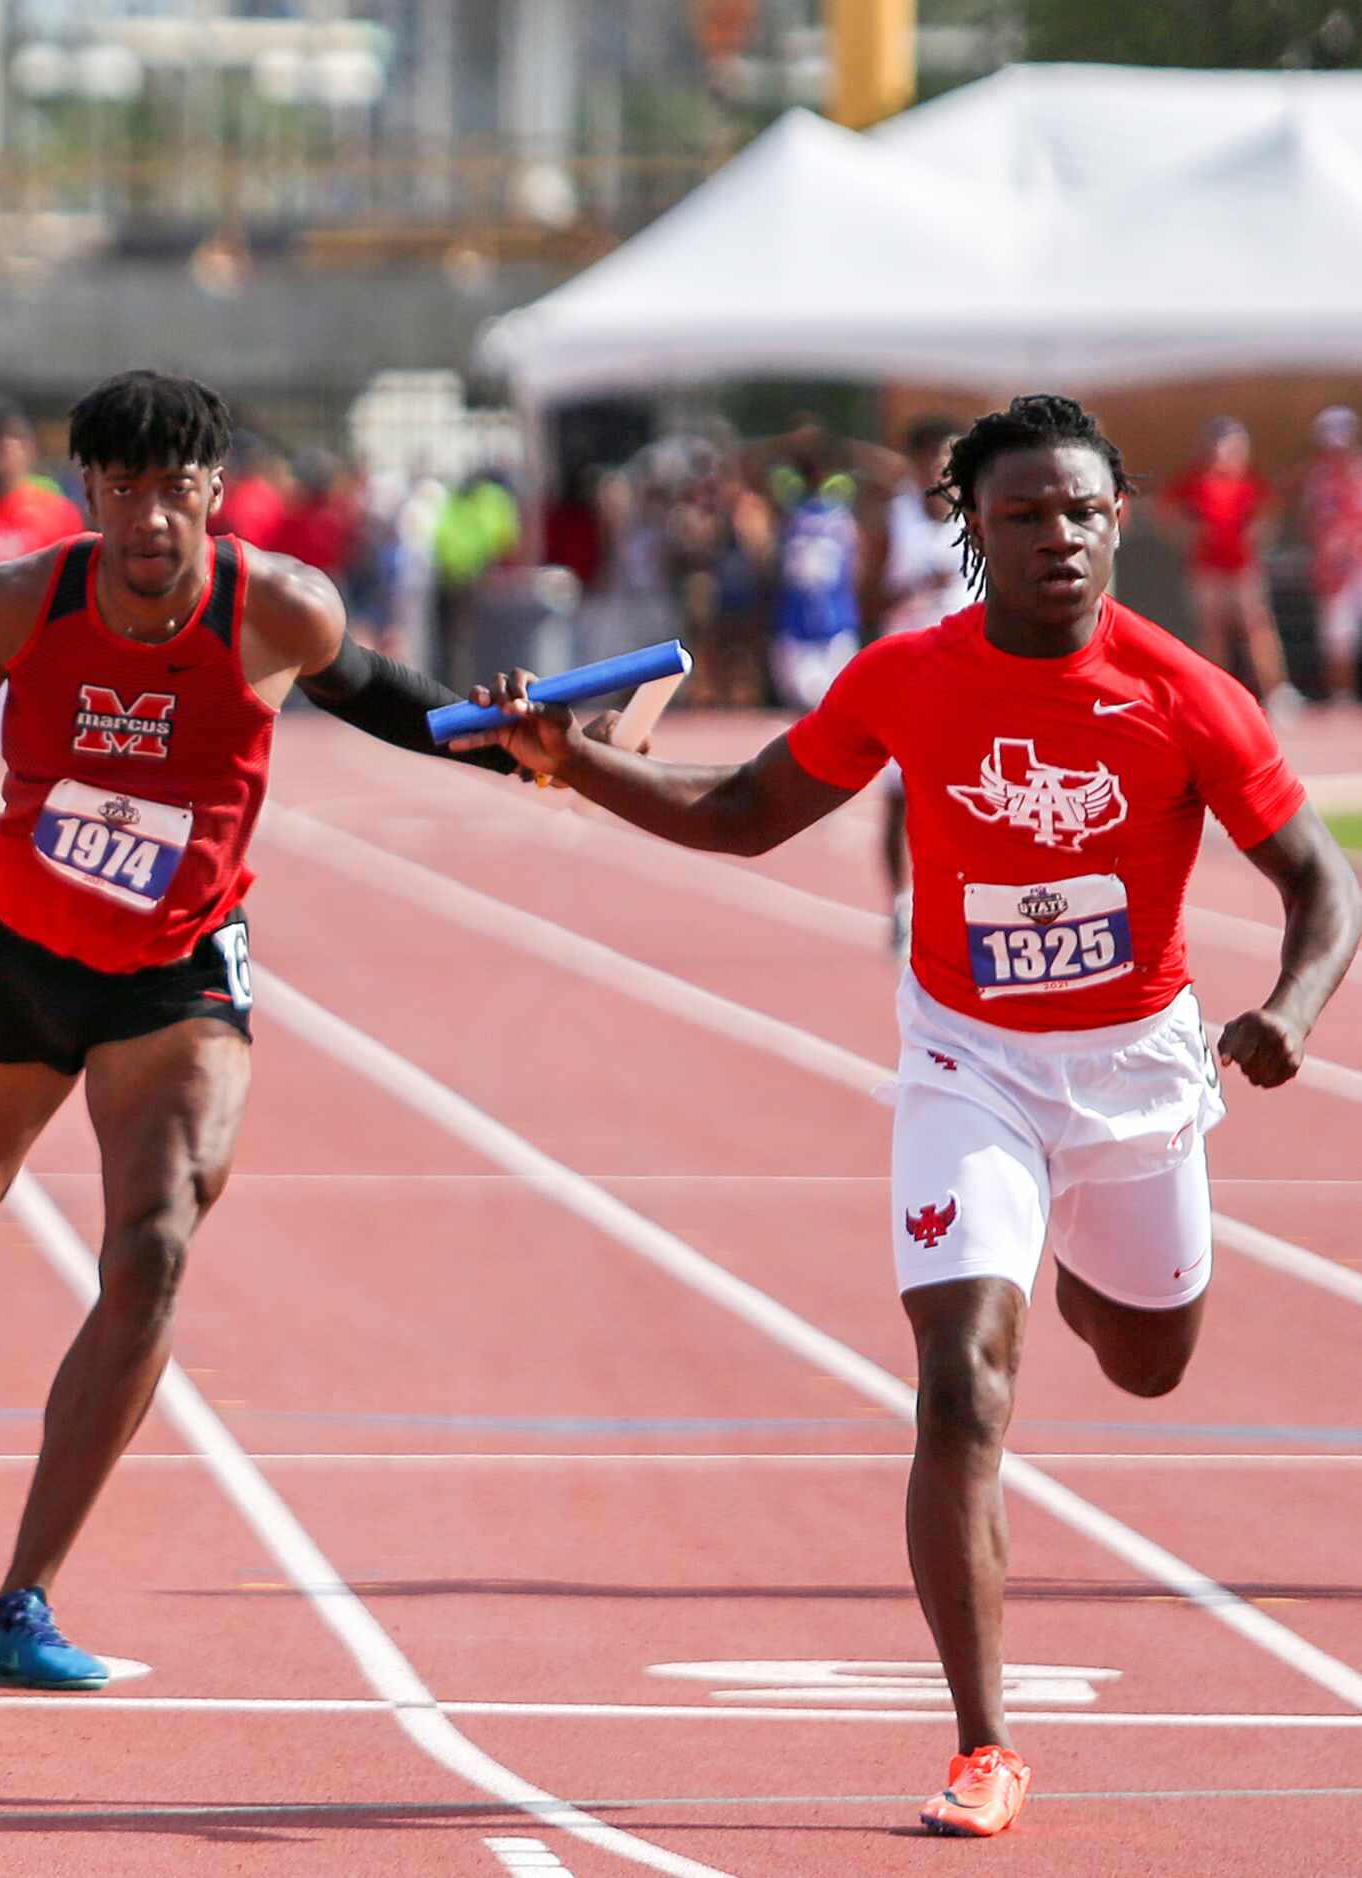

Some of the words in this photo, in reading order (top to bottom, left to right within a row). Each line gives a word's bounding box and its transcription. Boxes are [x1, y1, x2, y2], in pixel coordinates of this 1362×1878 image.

[74, 684, 175, 758] M
[77, 712, 171, 735] marcus
[53, 817, 161, 889] 1974
[1019, 898, 1068, 915] STATE
[234, 930, 252, 997] 6
[982, 917, 1116, 981] 1325
